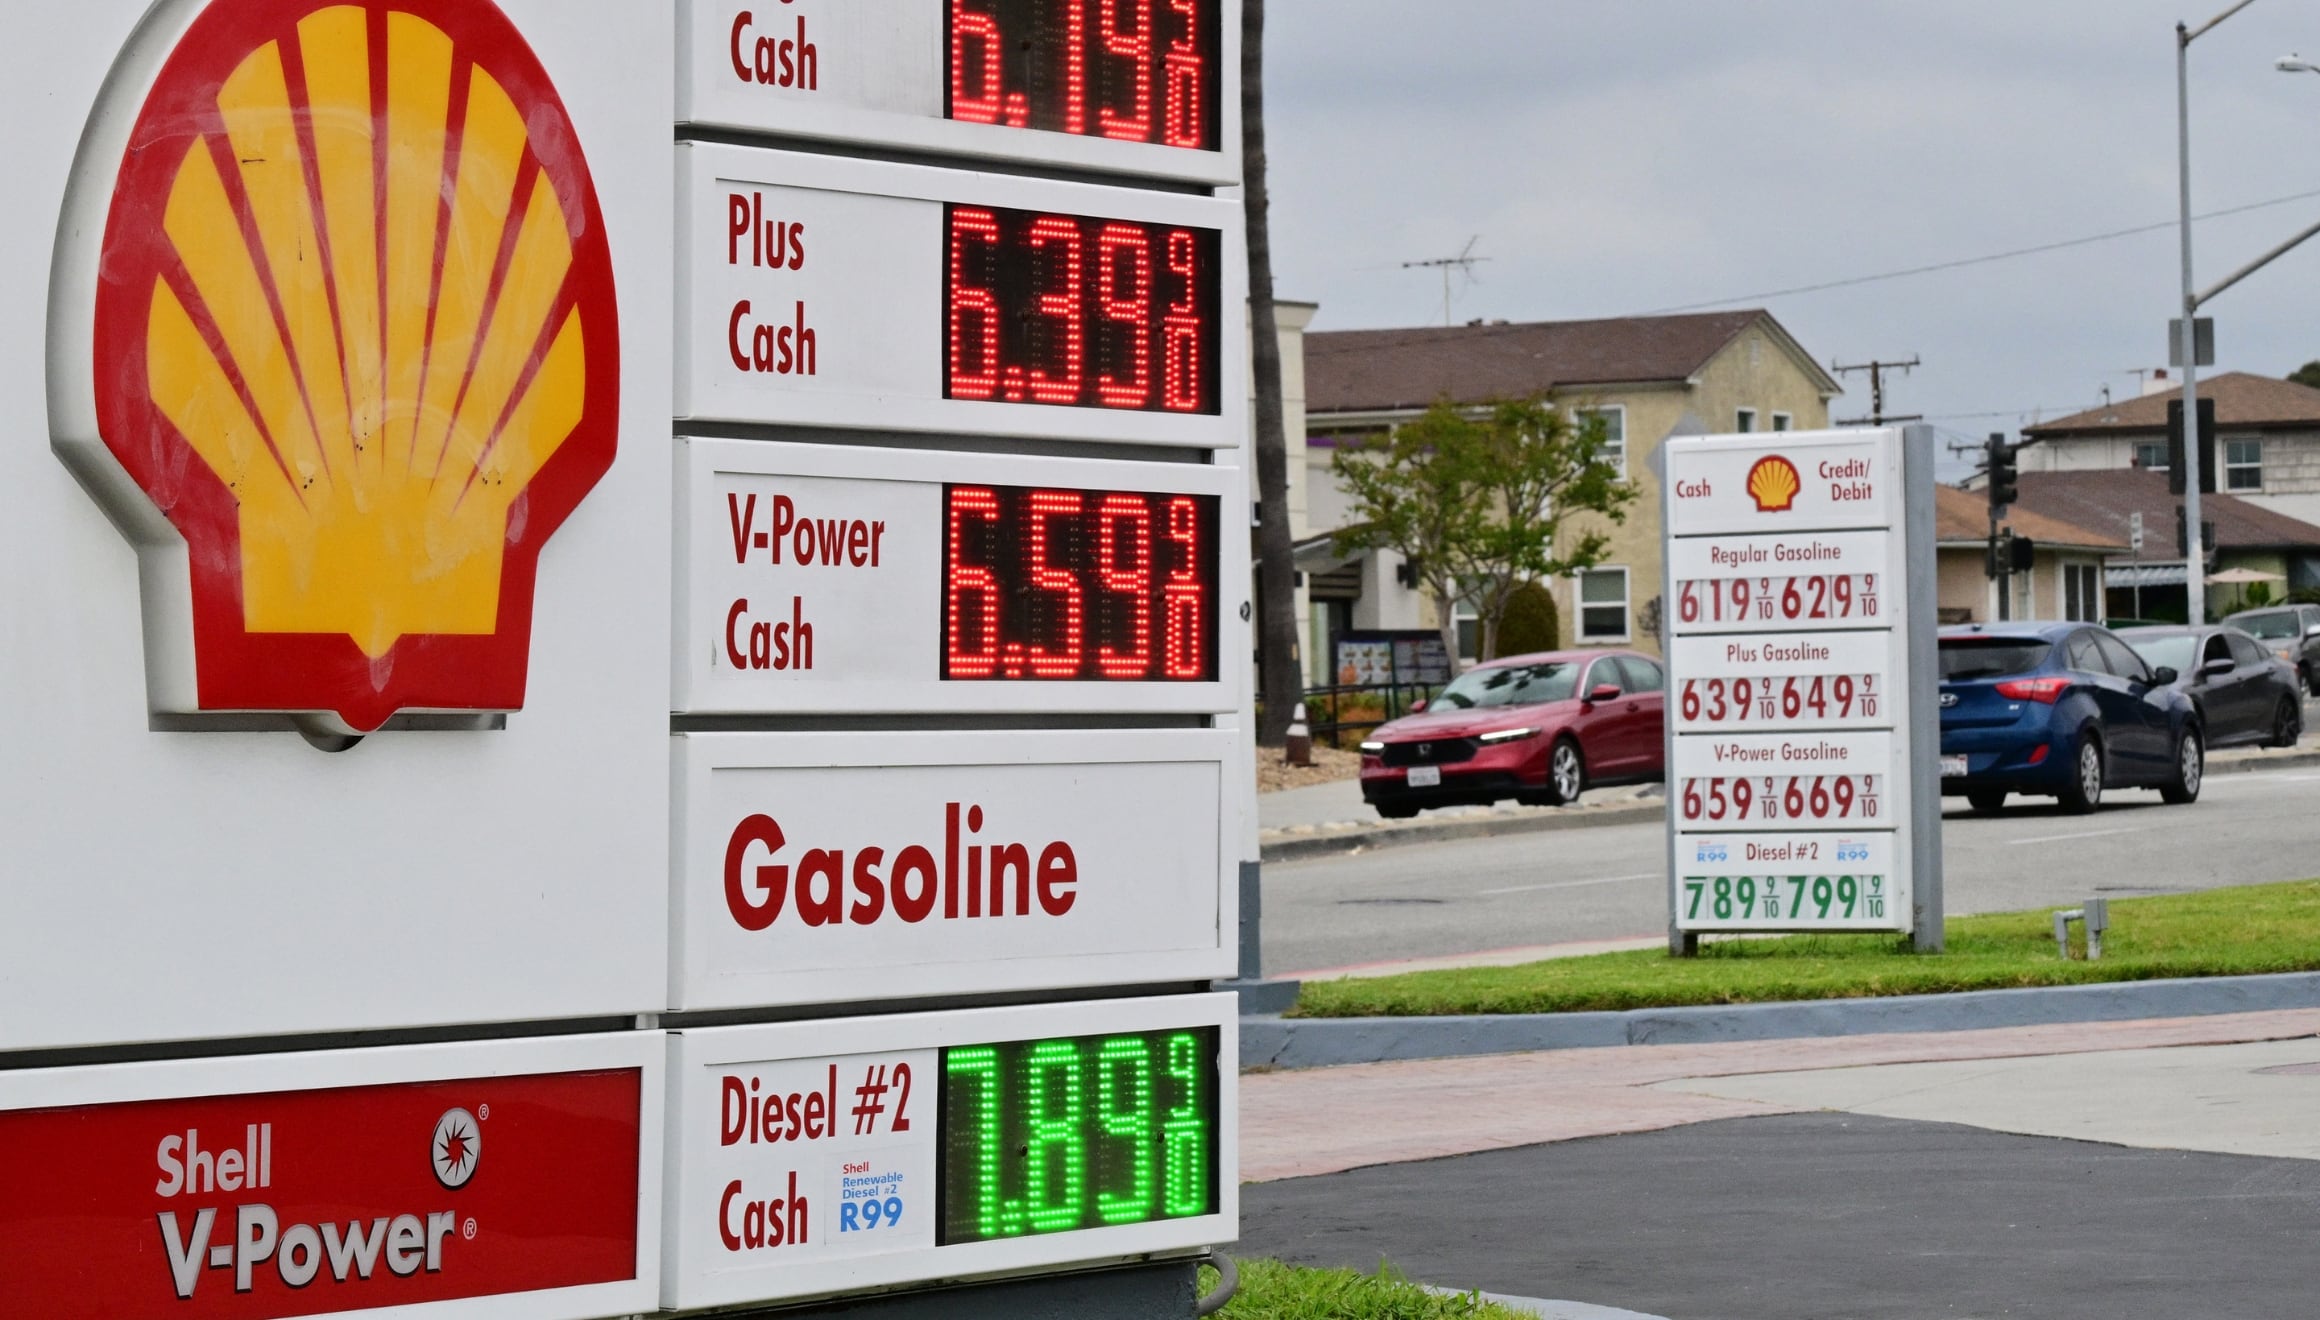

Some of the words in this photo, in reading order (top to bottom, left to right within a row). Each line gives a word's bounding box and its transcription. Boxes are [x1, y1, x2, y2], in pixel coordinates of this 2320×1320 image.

[731, 11, 816, 90] Cash
[729, 192, 804, 270] Plus
[951, 209, 1150, 407] 6.39
[729, 300, 816, 375] Cash
[1676, 478, 1711, 498] Cash
[1818, 458, 1871, 480] Credit/
[1831, 483, 1873, 501] Debit
[728, 493, 884, 567] V-Power
[1711, 544, 1768, 568] Regular
[1774, 542, 1841, 562] Gasoline
[949, 488, 1150, 678] 6.59
[1680, 579, 1750, 622] 619
[1781, 574, 1852, 619] 629
[726, 596, 813, 670] Cash
[1727, 644, 1757, 662] Plus
[1763, 642, 1829, 662] Gasoline
[1681, 678, 1751, 721] 639
[1782, 675, 1853, 719] 649
[1714, 743, 1775, 762] V-Power
[1781, 741, 1848, 761] Gasoline
[1683, 777, 1752, 820] 659
[1784, 775, 1854, 818] 669
[724, 802, 1077, 931] Gasoline
[1746, 841, 1791, 861] Diesel
[1795, 842, 1819, 861] #2
[1685, 877, 1756, 920] 789
[1787, 876, 1858, 919] 799
[721, 1064, 836, 1146] Diesel
[852, 1063, 911, 1134] #2
[946, 1039, 1150, 1236] 7.89
[155, 1123, 271, 1197] Shell
[842, 1161, 869, 1175] Shell
[842, 1172, 903, 1188] Renewable
[719, 1172, 807, 1251] Cash
[842, 1186, 879, 1199] Diesel
[884, 1184, 897, 1194] #2
[840, 1197, 903, 1232] R99
